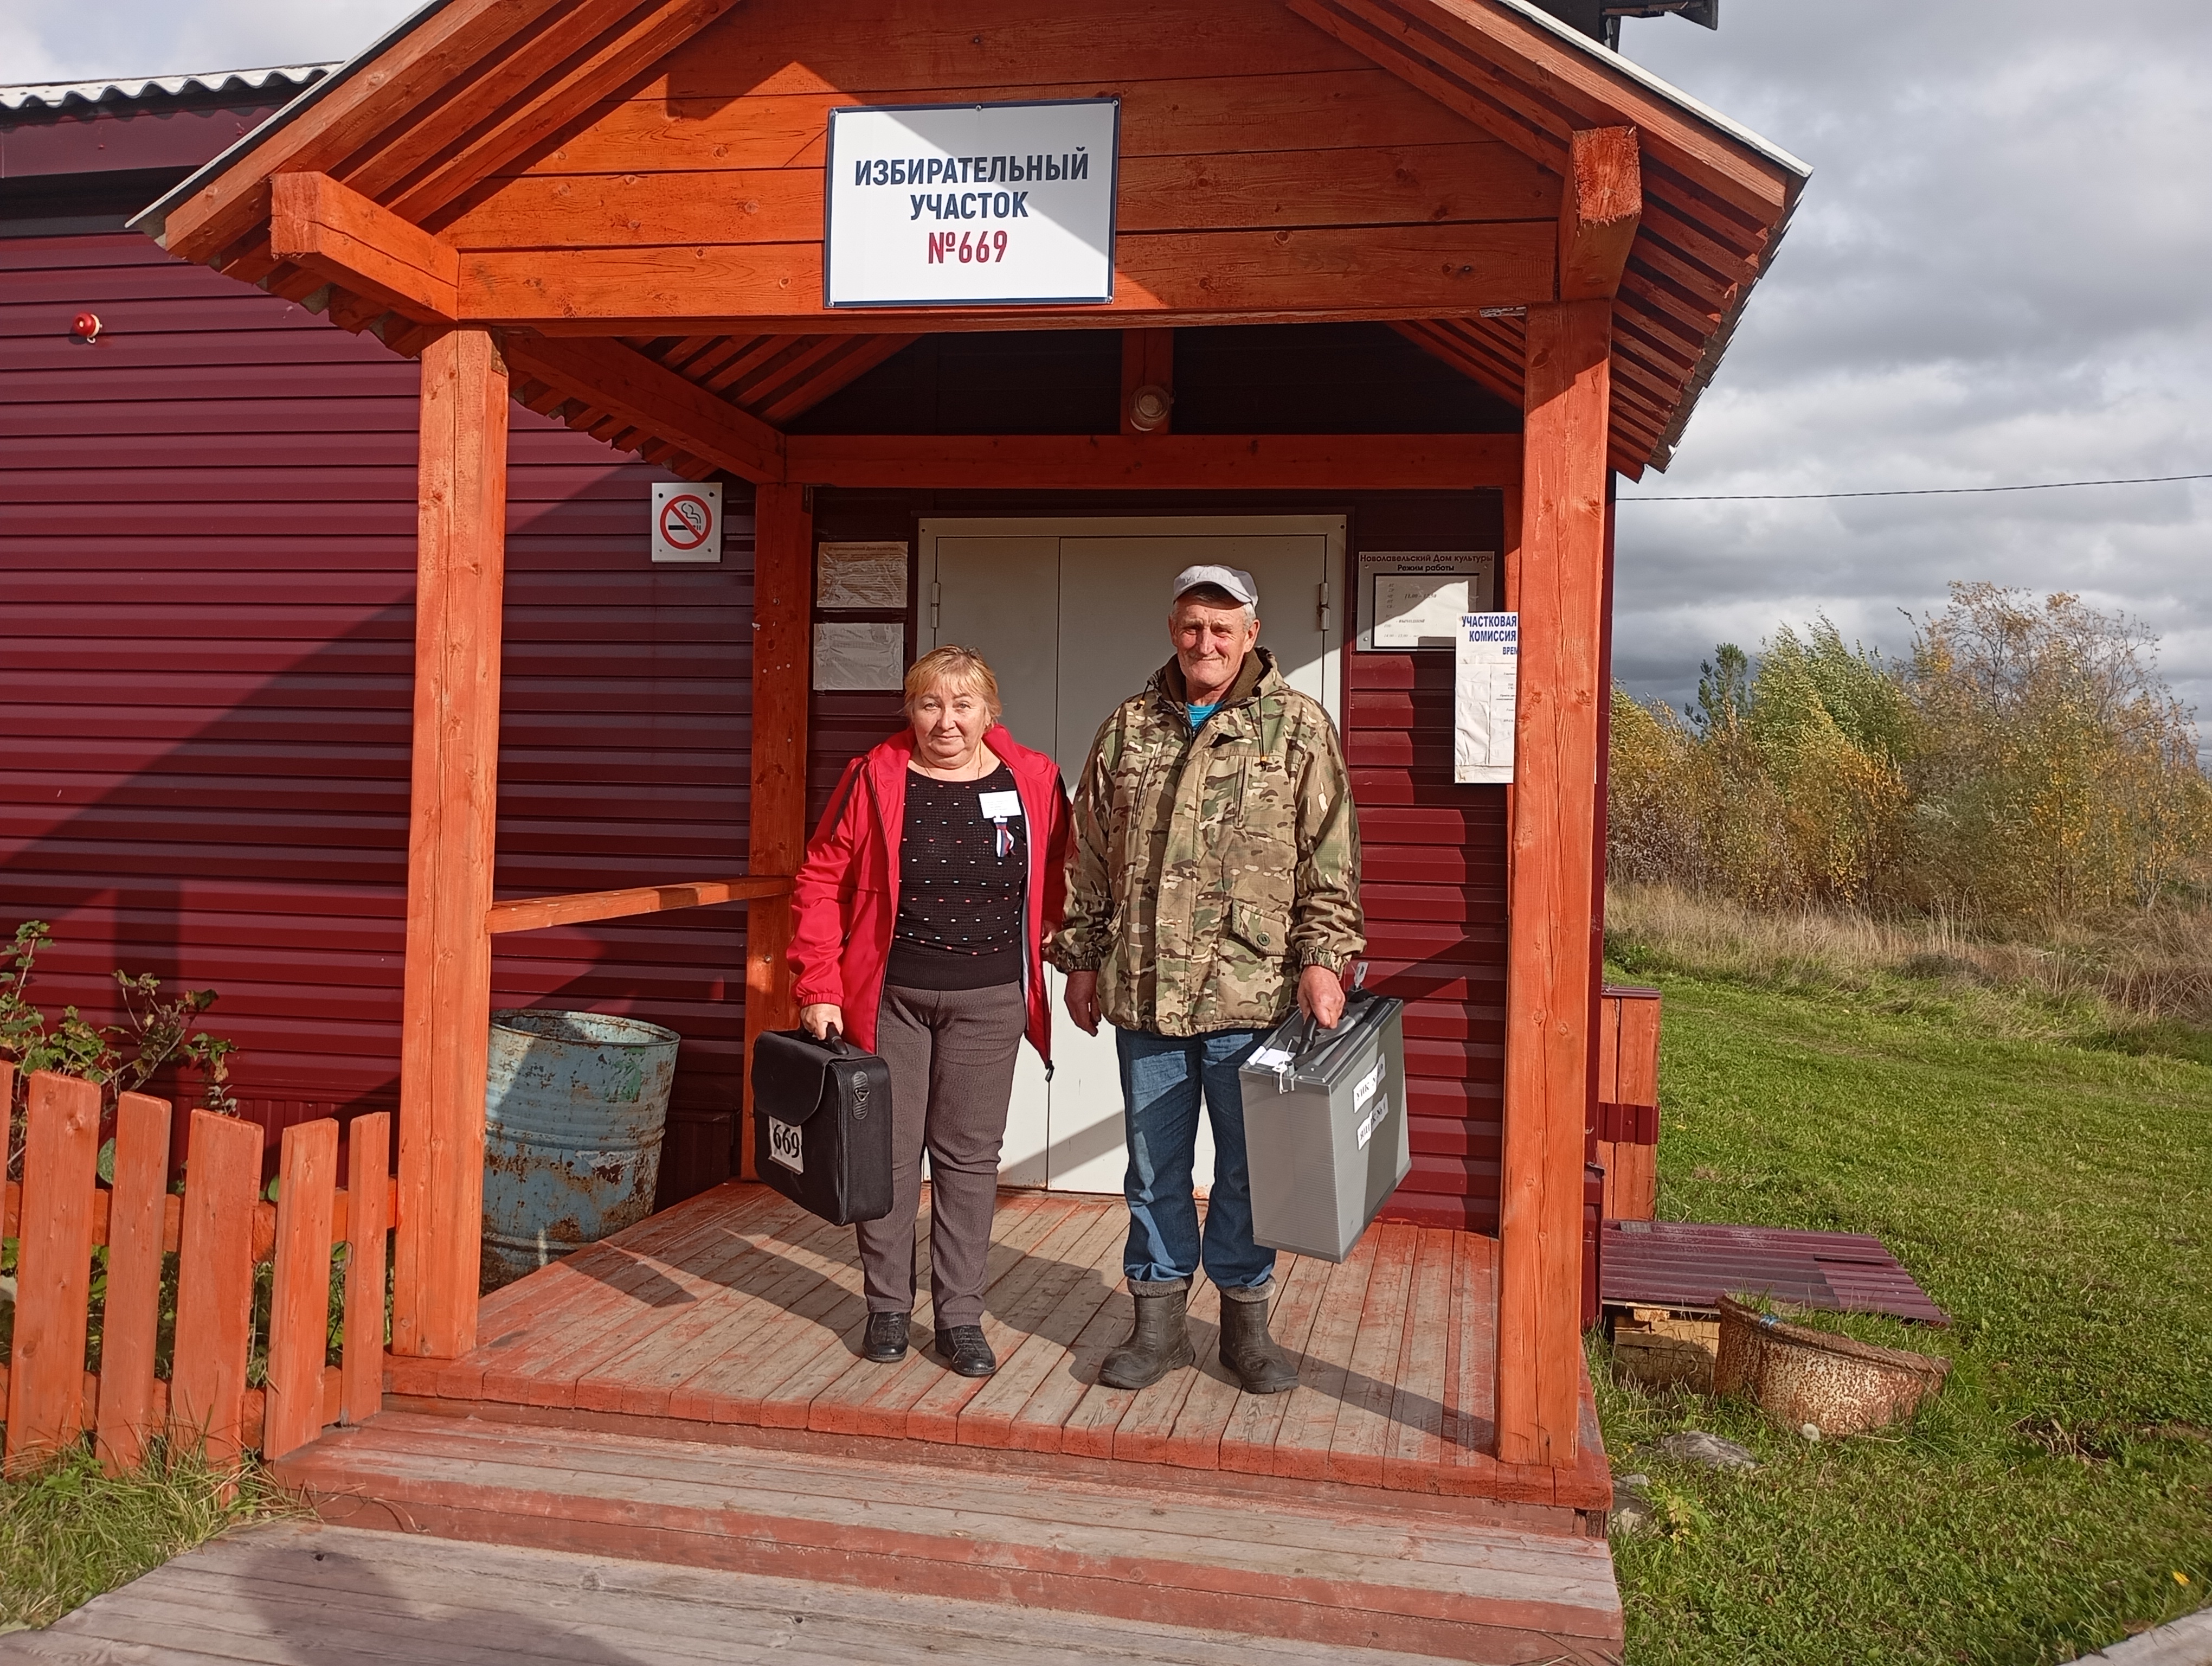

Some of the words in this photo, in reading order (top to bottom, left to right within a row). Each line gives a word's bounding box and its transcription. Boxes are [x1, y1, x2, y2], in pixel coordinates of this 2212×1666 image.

[854, 146, 1089, 187] ИЗБИРАТЕЛЬНЫЙ
[910, 191, 1029, 221] УЧАСТОК
[928, 230, 1008, 265] №669
[1425, 564, 1454, 572] работы
[1433, 554, 1451, 563] Дом
[1454, 555, 1493, 563] культуры
[1462, 616, 1517, 627] УЧАСТКОВАЯ
[1469, 630, 1516, 642] КОМИССИЯ
[773, 1124, 800, 1158] 669
